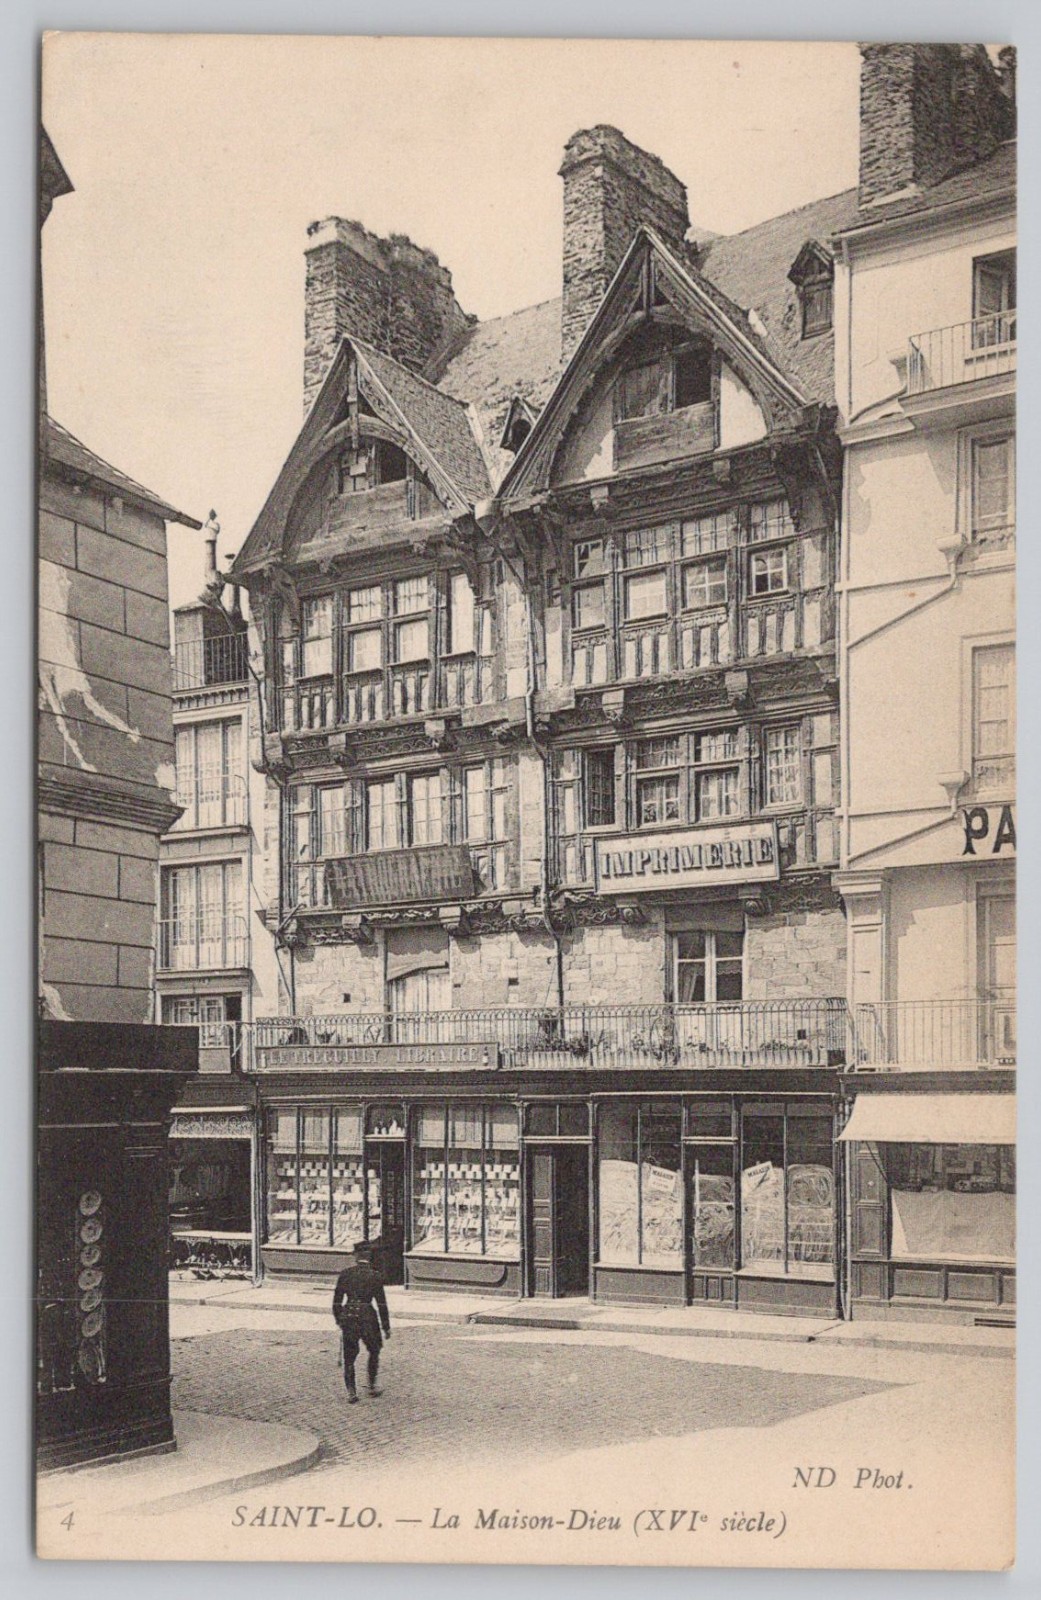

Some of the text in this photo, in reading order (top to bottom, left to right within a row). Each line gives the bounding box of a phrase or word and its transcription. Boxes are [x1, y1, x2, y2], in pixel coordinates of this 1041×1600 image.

[601, 837, 774, 879] IMPRIMERIE
[269, 1049, 288, 1066] LE
[396, 1046, 478, 1064] LIBRAIRE
